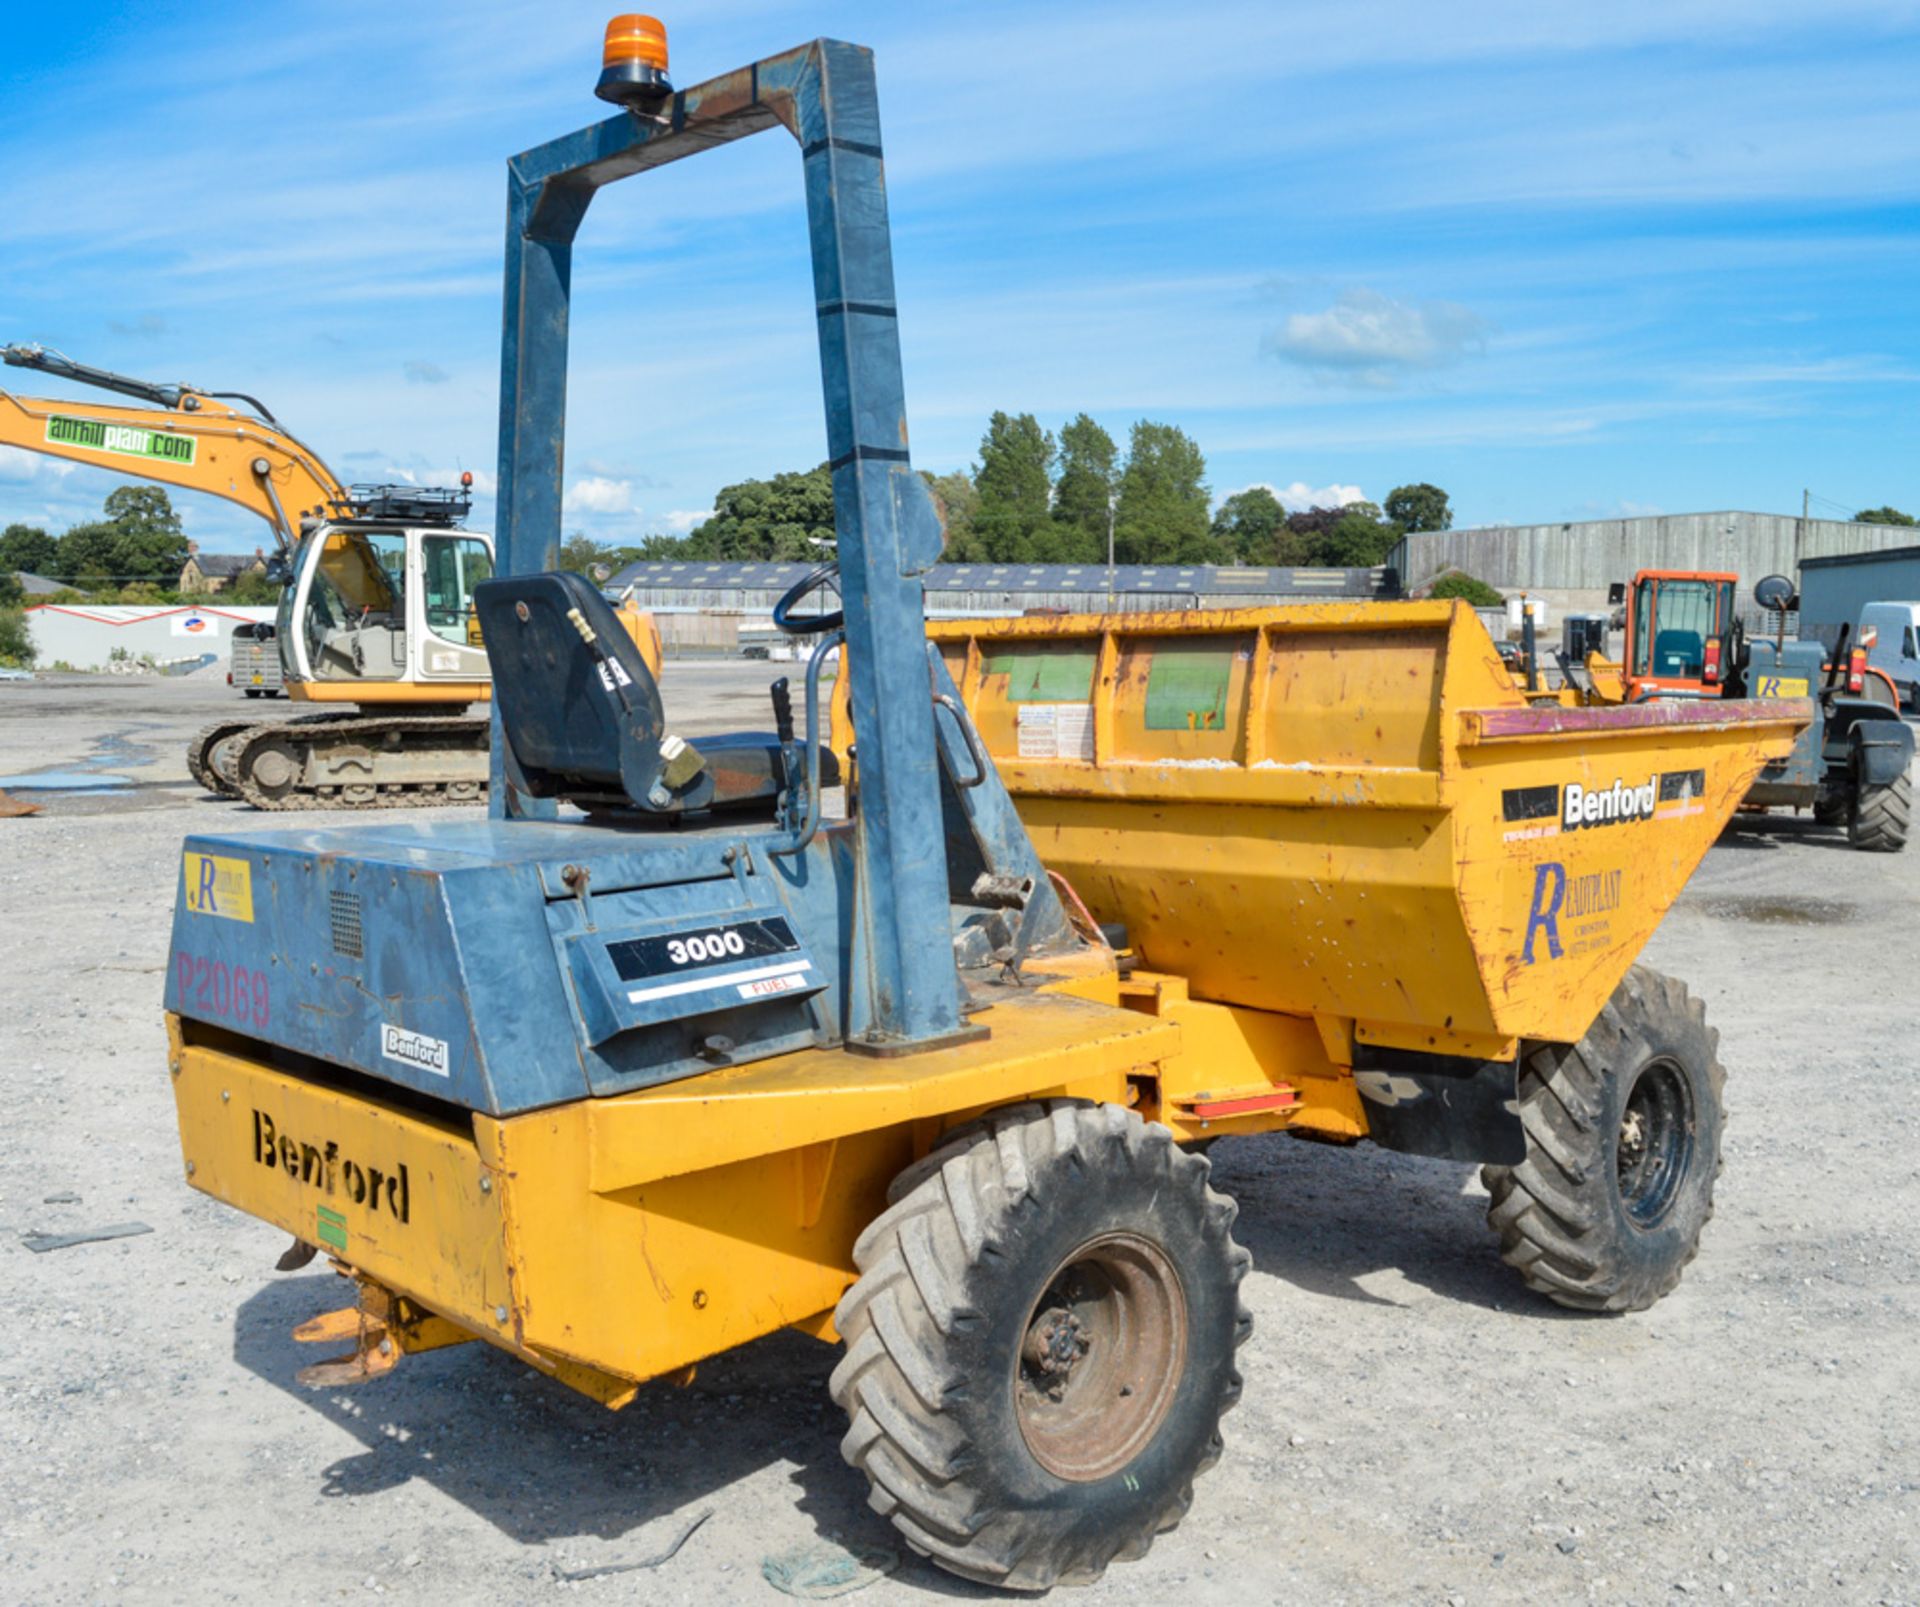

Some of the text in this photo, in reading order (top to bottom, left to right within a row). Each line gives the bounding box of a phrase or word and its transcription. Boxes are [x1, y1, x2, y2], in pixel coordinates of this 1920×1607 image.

[1562, 774, 1657, 831] Benford
[667, 930, 745, 964] 3000
[176, 951, 270, 1029] P2069
[751, 977, 792, 994] FUEL
[386, 1029, 445, 1069] Benford
[252, 1109, 410, 1224] Benford
